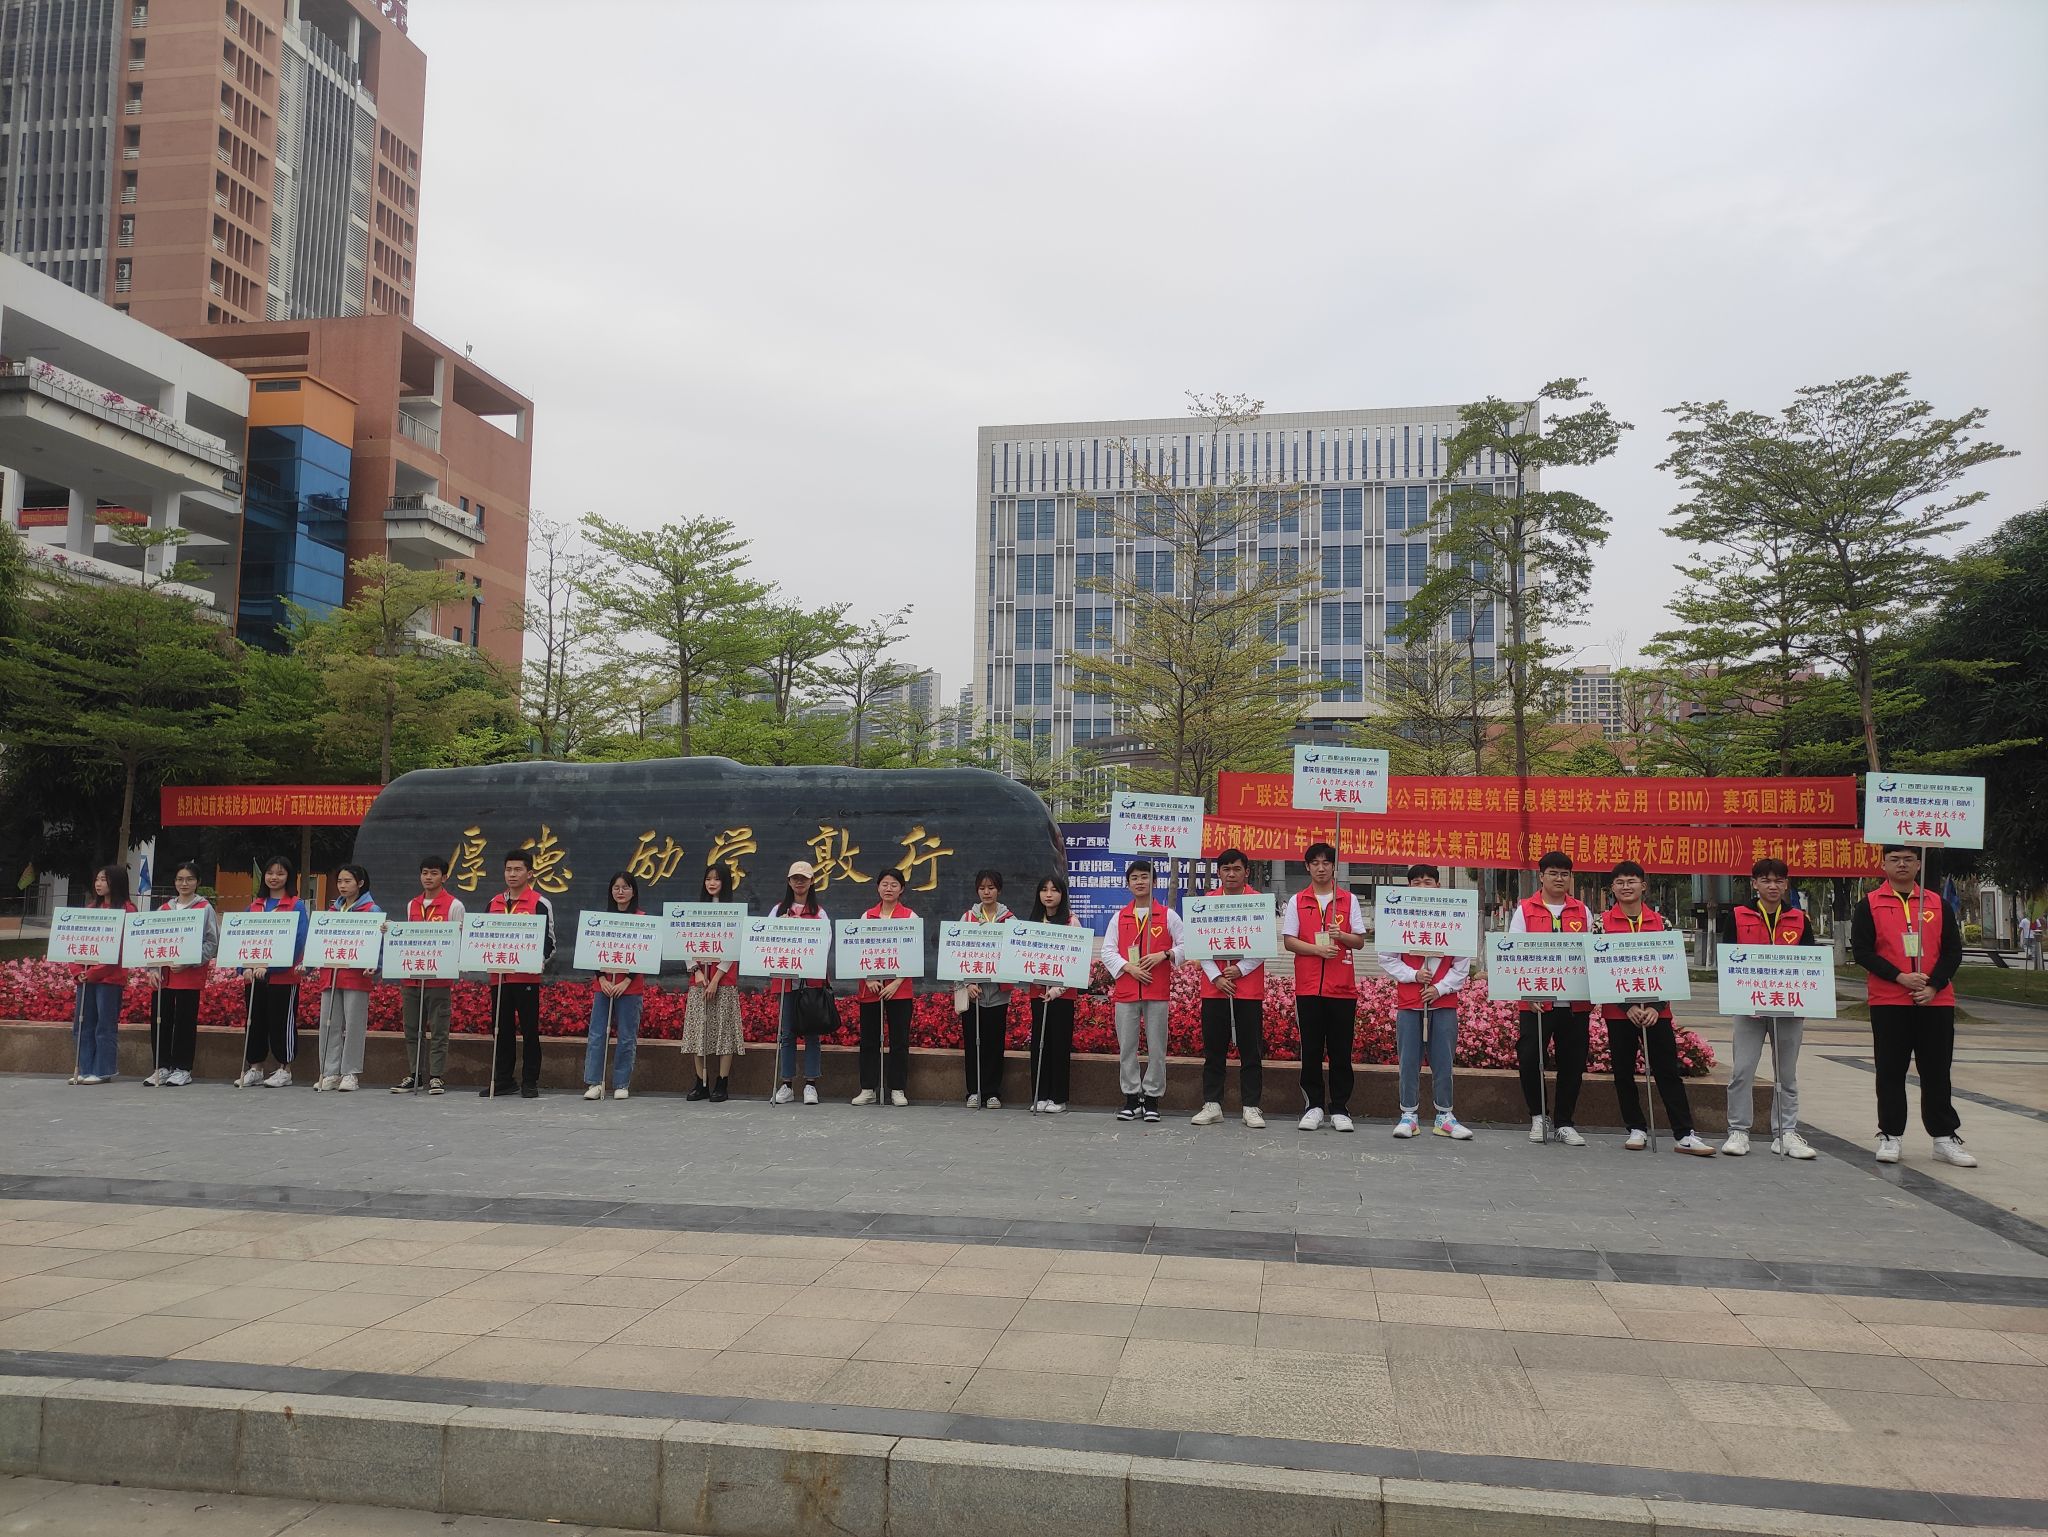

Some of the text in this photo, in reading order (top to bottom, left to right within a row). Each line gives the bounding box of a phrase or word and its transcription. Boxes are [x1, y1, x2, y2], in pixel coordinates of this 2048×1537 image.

[1308, 777, 1374, 789] 广西电力职业技术学院
[1319, 788, 1362, 804] 代表队
[1882, 808, 1967, 821] 广西机电职业技术学院
[1897, 820, 1950, 838] 代表队
[1134, 834, 1176, 849] 代表队
[1208, 936, 1251, 950] 代表队
[1402, 930, 1448, 946] 代表队
[67, 943, 99, 956] 代表队
[144, 946, 180, 959] 代表队
[685, 940, 724, 953] 代表队
[862, 947, 898, 956] 北海职业学院
[238, 947, 273, 960] 代表队
[325, 947, 358, 960] 代表队
[482, 952, 520, 965] 代表队
[598, 950, 637, 965] 代表队
[402, 959, 438, 971] 代表队
[763, 956, 803, 970] 代表队
[859, 957, 900, 971] 代表队
[960, 961, 997, 975] 代表队
[1024, 961, 1064, 977] 代表队
[1496, 965, 1586, 976] 广西生态工程职业技术学院
[1609, 965, 1665, 976] 南宁职业技术学院
[1517, 976, 1566, 992] 代表队
[1616, 977, 1662, 993] 代表队
[1736, 979, 1818, 990] 柳州铁道职业技术学院
[1751, 991, 1804, 1007] 代表队
